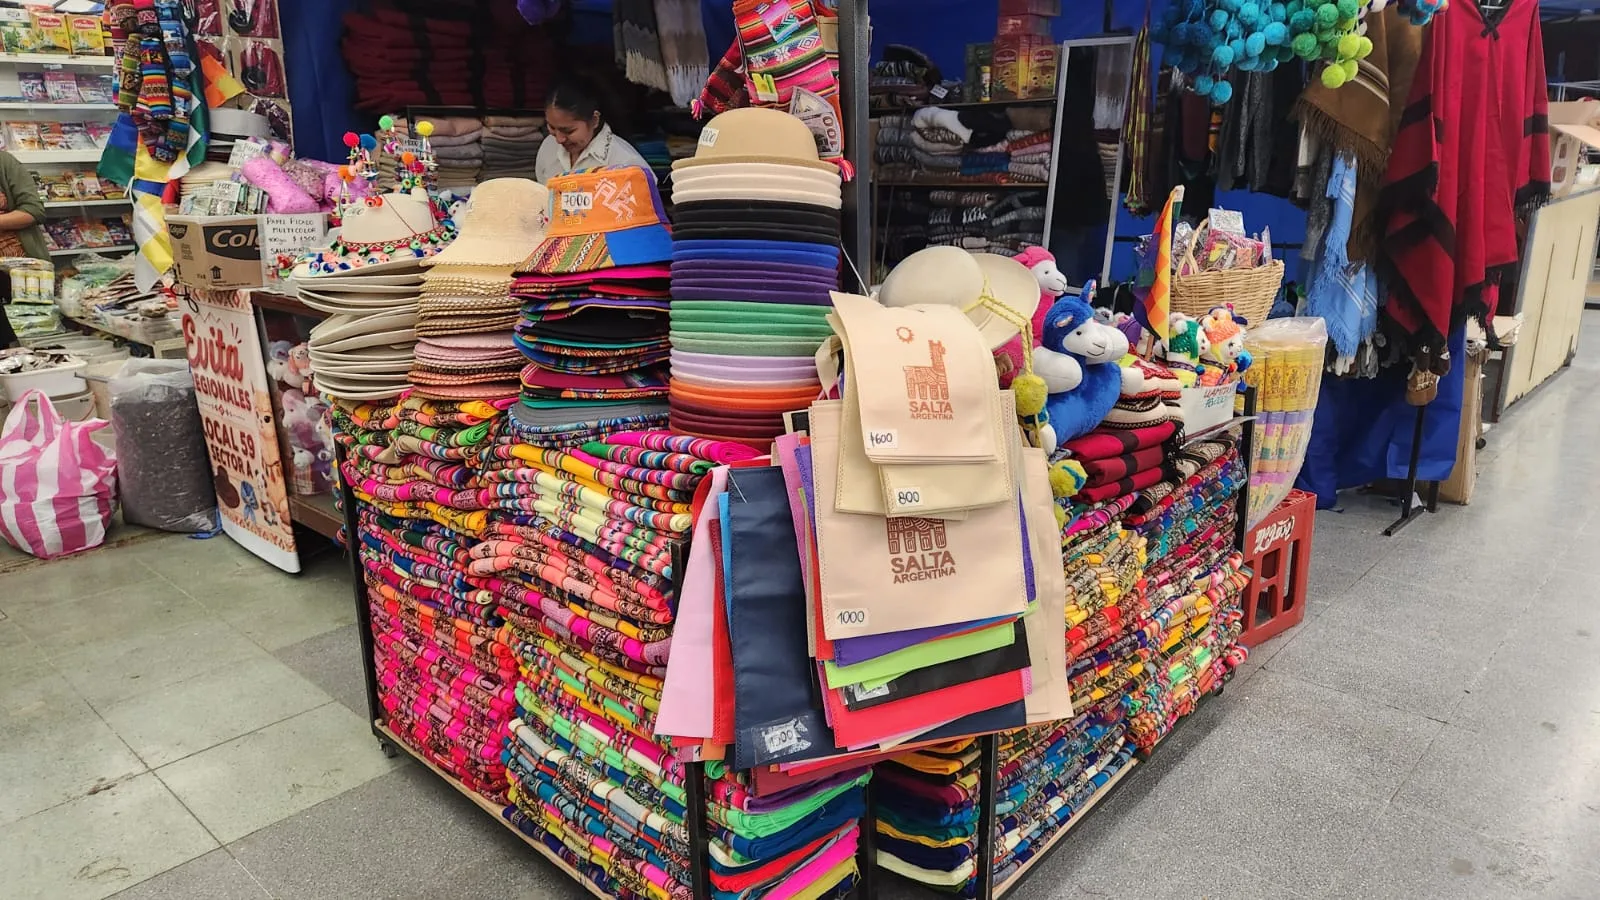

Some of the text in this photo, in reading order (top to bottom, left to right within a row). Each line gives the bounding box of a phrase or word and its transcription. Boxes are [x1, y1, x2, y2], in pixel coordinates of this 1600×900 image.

[562, 193, 590, 207] 7000
[181, 312, 244, 383] Evita
[194, 372, 252, 412] EGIONALES
[909, 401, 953, 413] SALTA
[910, 413, 954, 421] ARGENTINA
[239, 430, 256, 460] 59
[211, 443, 254, 479] SECTOR A
[898, 491, 920, 504] 800
[891, 550, 956, 574] SALTA
[893, 567, 956, 585] ARGENTINA
[837, 610, 865, 625] 1000
